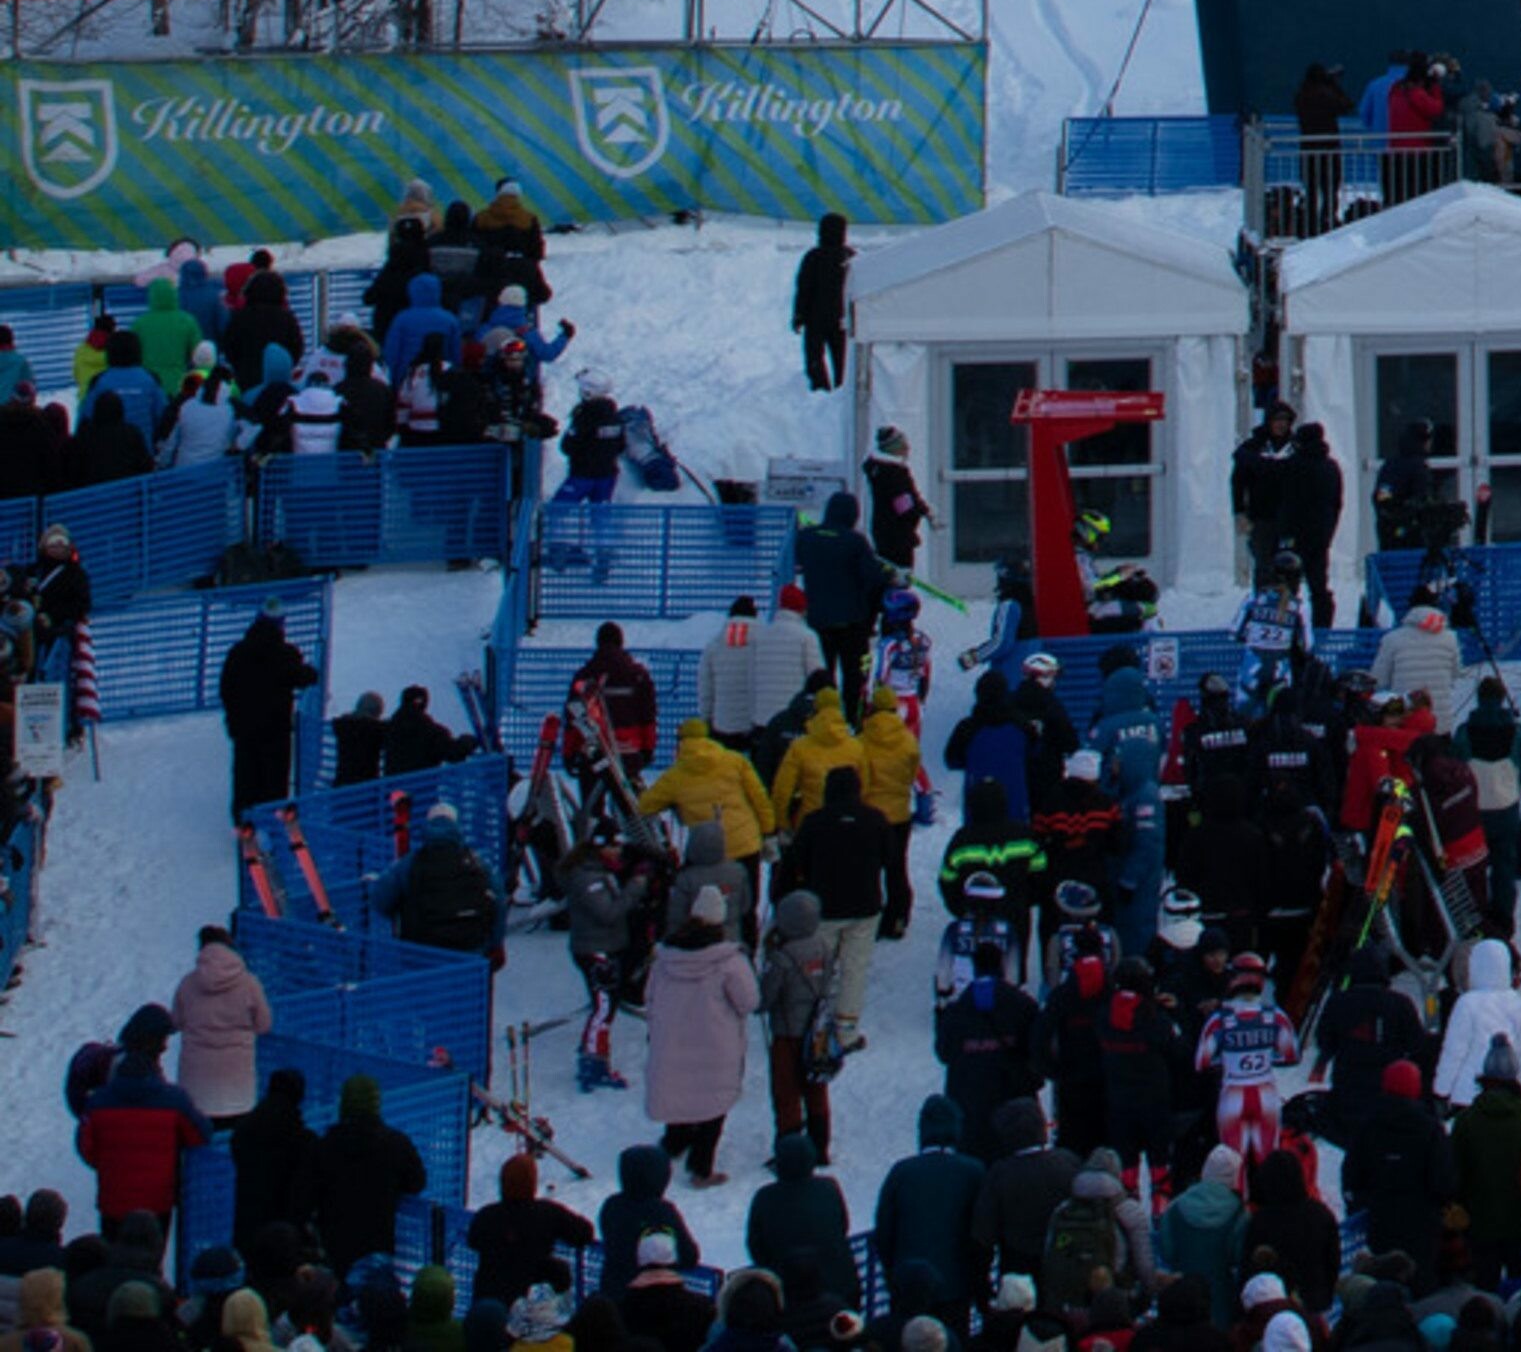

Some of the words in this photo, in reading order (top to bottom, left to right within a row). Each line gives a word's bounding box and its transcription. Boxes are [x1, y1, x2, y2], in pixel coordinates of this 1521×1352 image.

[132, 93, 386, 155] Killington
[682, 80, 904, 136] Killington
[1240, 1055, 1264, 1074] 62
